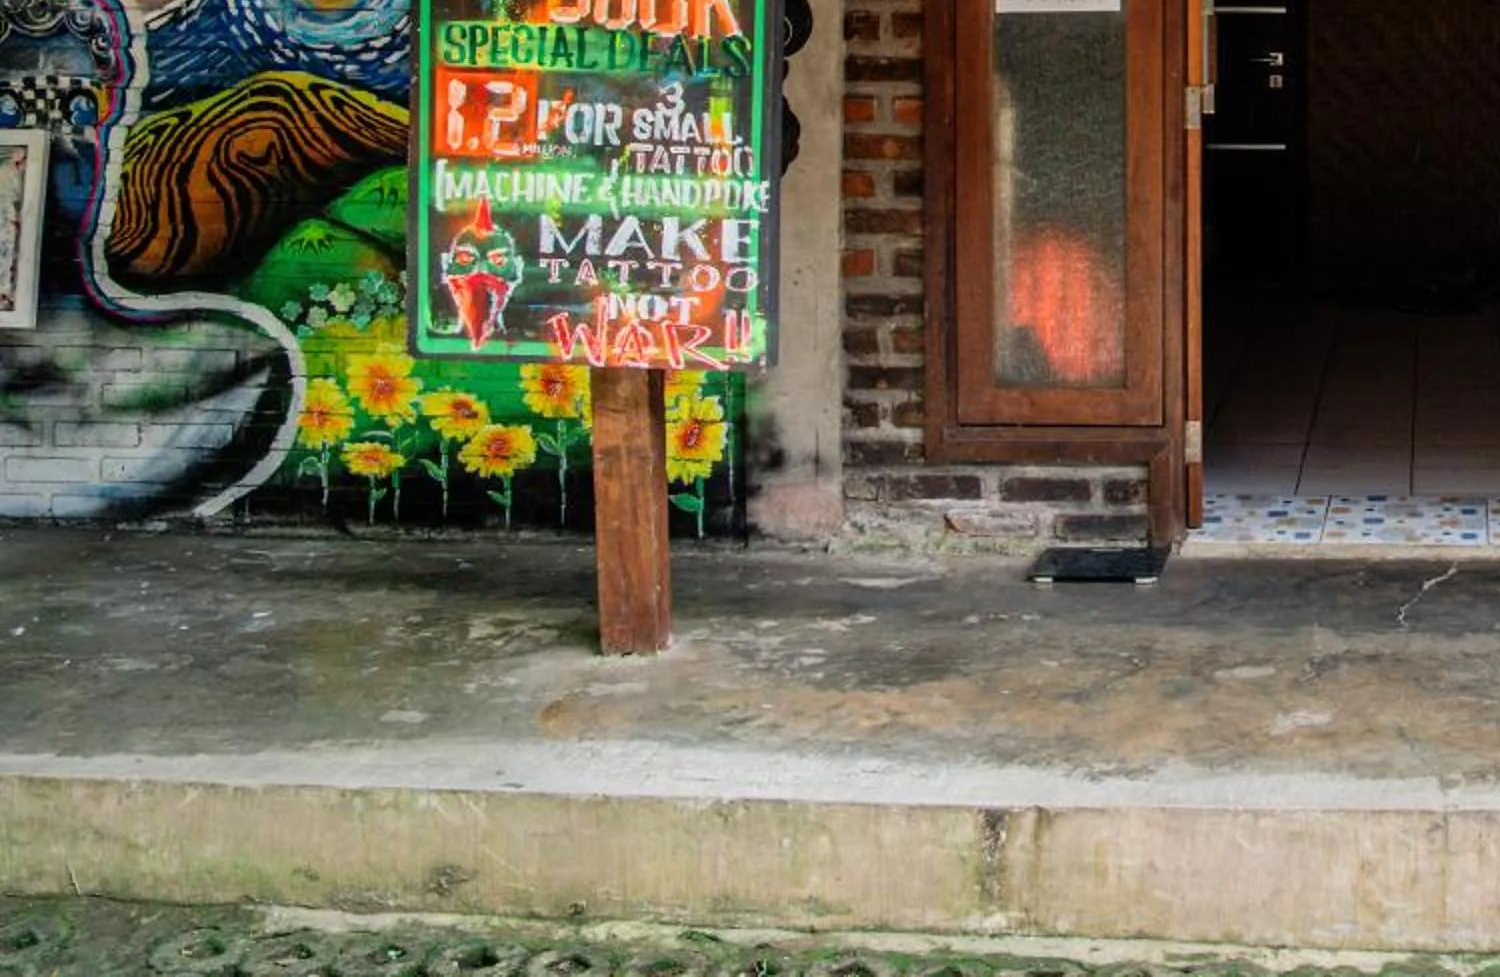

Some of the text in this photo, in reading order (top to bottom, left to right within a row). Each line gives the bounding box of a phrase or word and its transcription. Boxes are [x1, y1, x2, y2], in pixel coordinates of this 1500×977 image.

[442, 22, 752, 78] SPECIAL DEALS
[536, 98, 624, 147] FOR
[627, 142, 754, 177] TATTOO
[539, 213, 759, 263] MAKE
[538, 258, 760, 293] TATTOO
[606, 293, 700, 324] NOT
